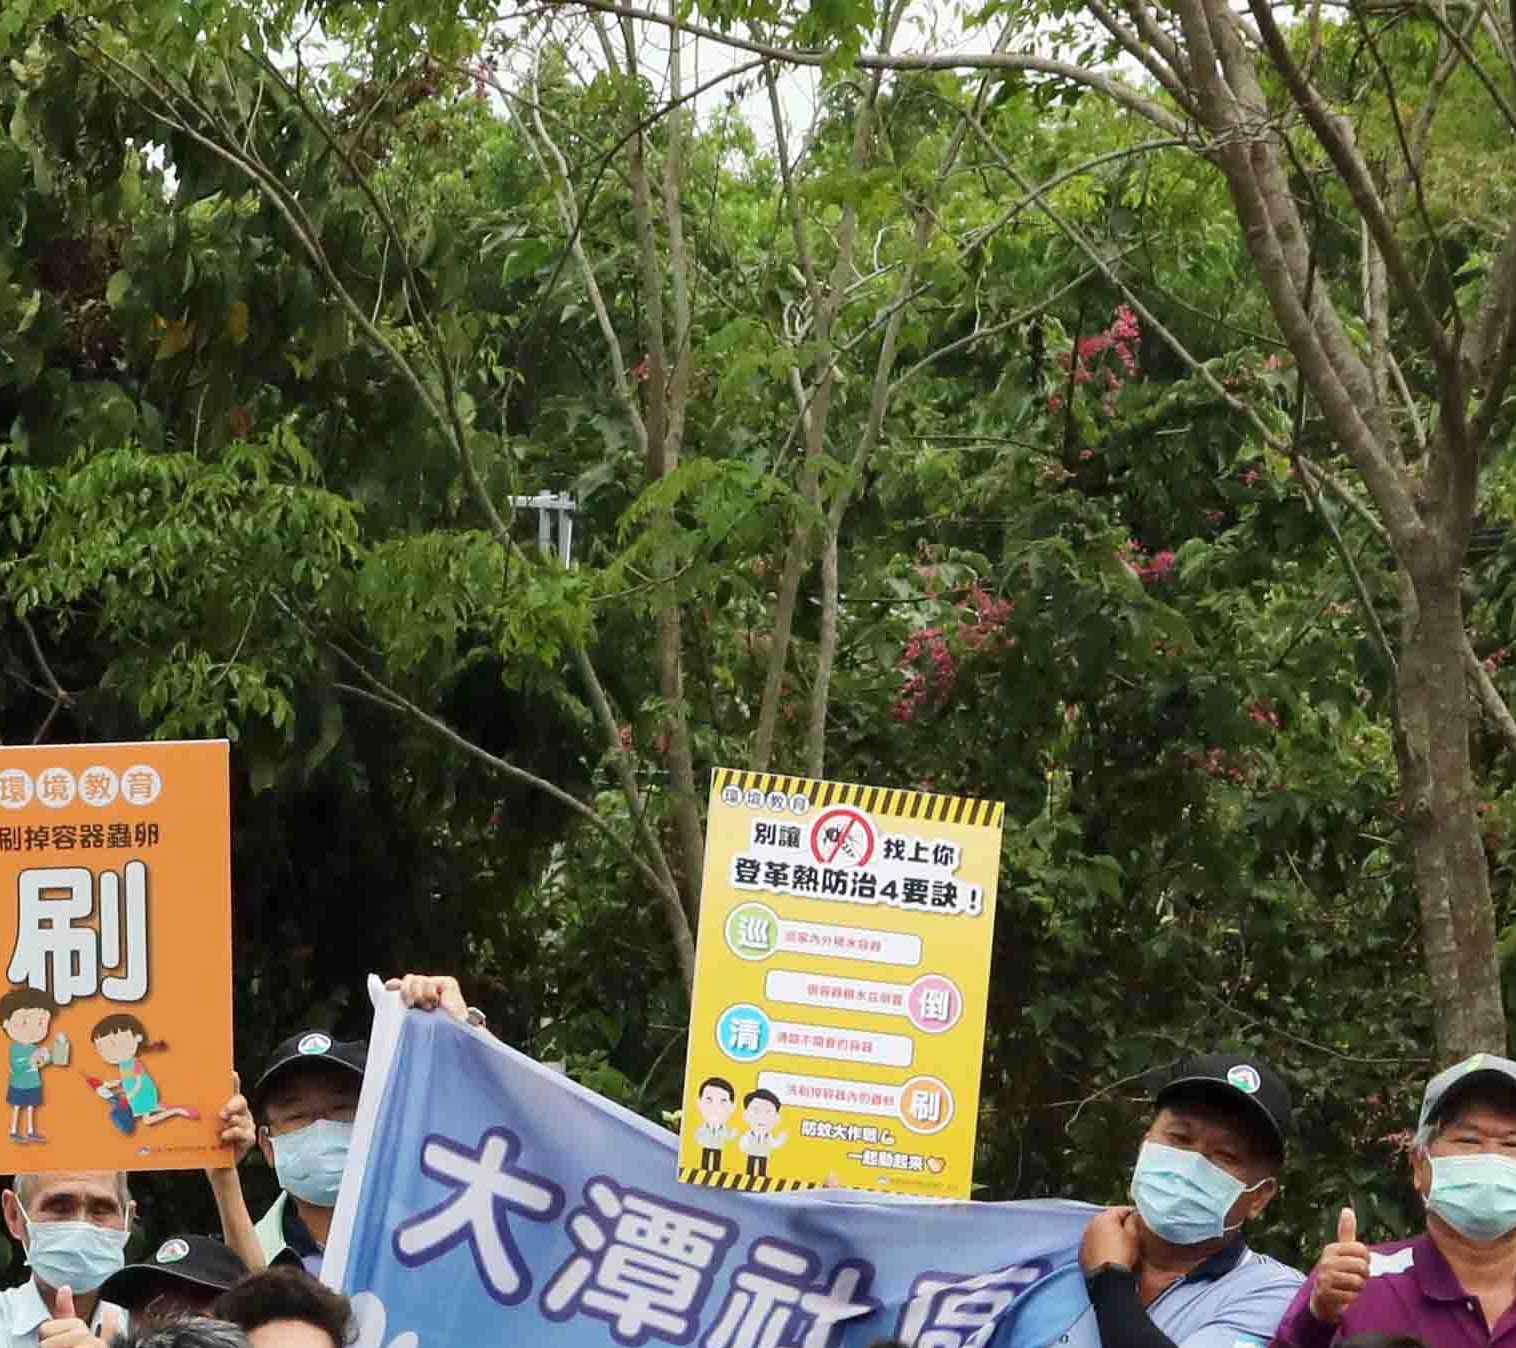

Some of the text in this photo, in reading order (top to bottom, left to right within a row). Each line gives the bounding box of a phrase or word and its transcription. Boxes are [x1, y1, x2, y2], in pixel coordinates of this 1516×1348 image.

[753, 822, 957, 868] 別讓 找上你
[6, 859, 148, 1005] 刷
[919, 990, 952, 1022] 倒
[728, 1016, 762, 1052] 清
[909, 1089, 943, 1122] 刷
